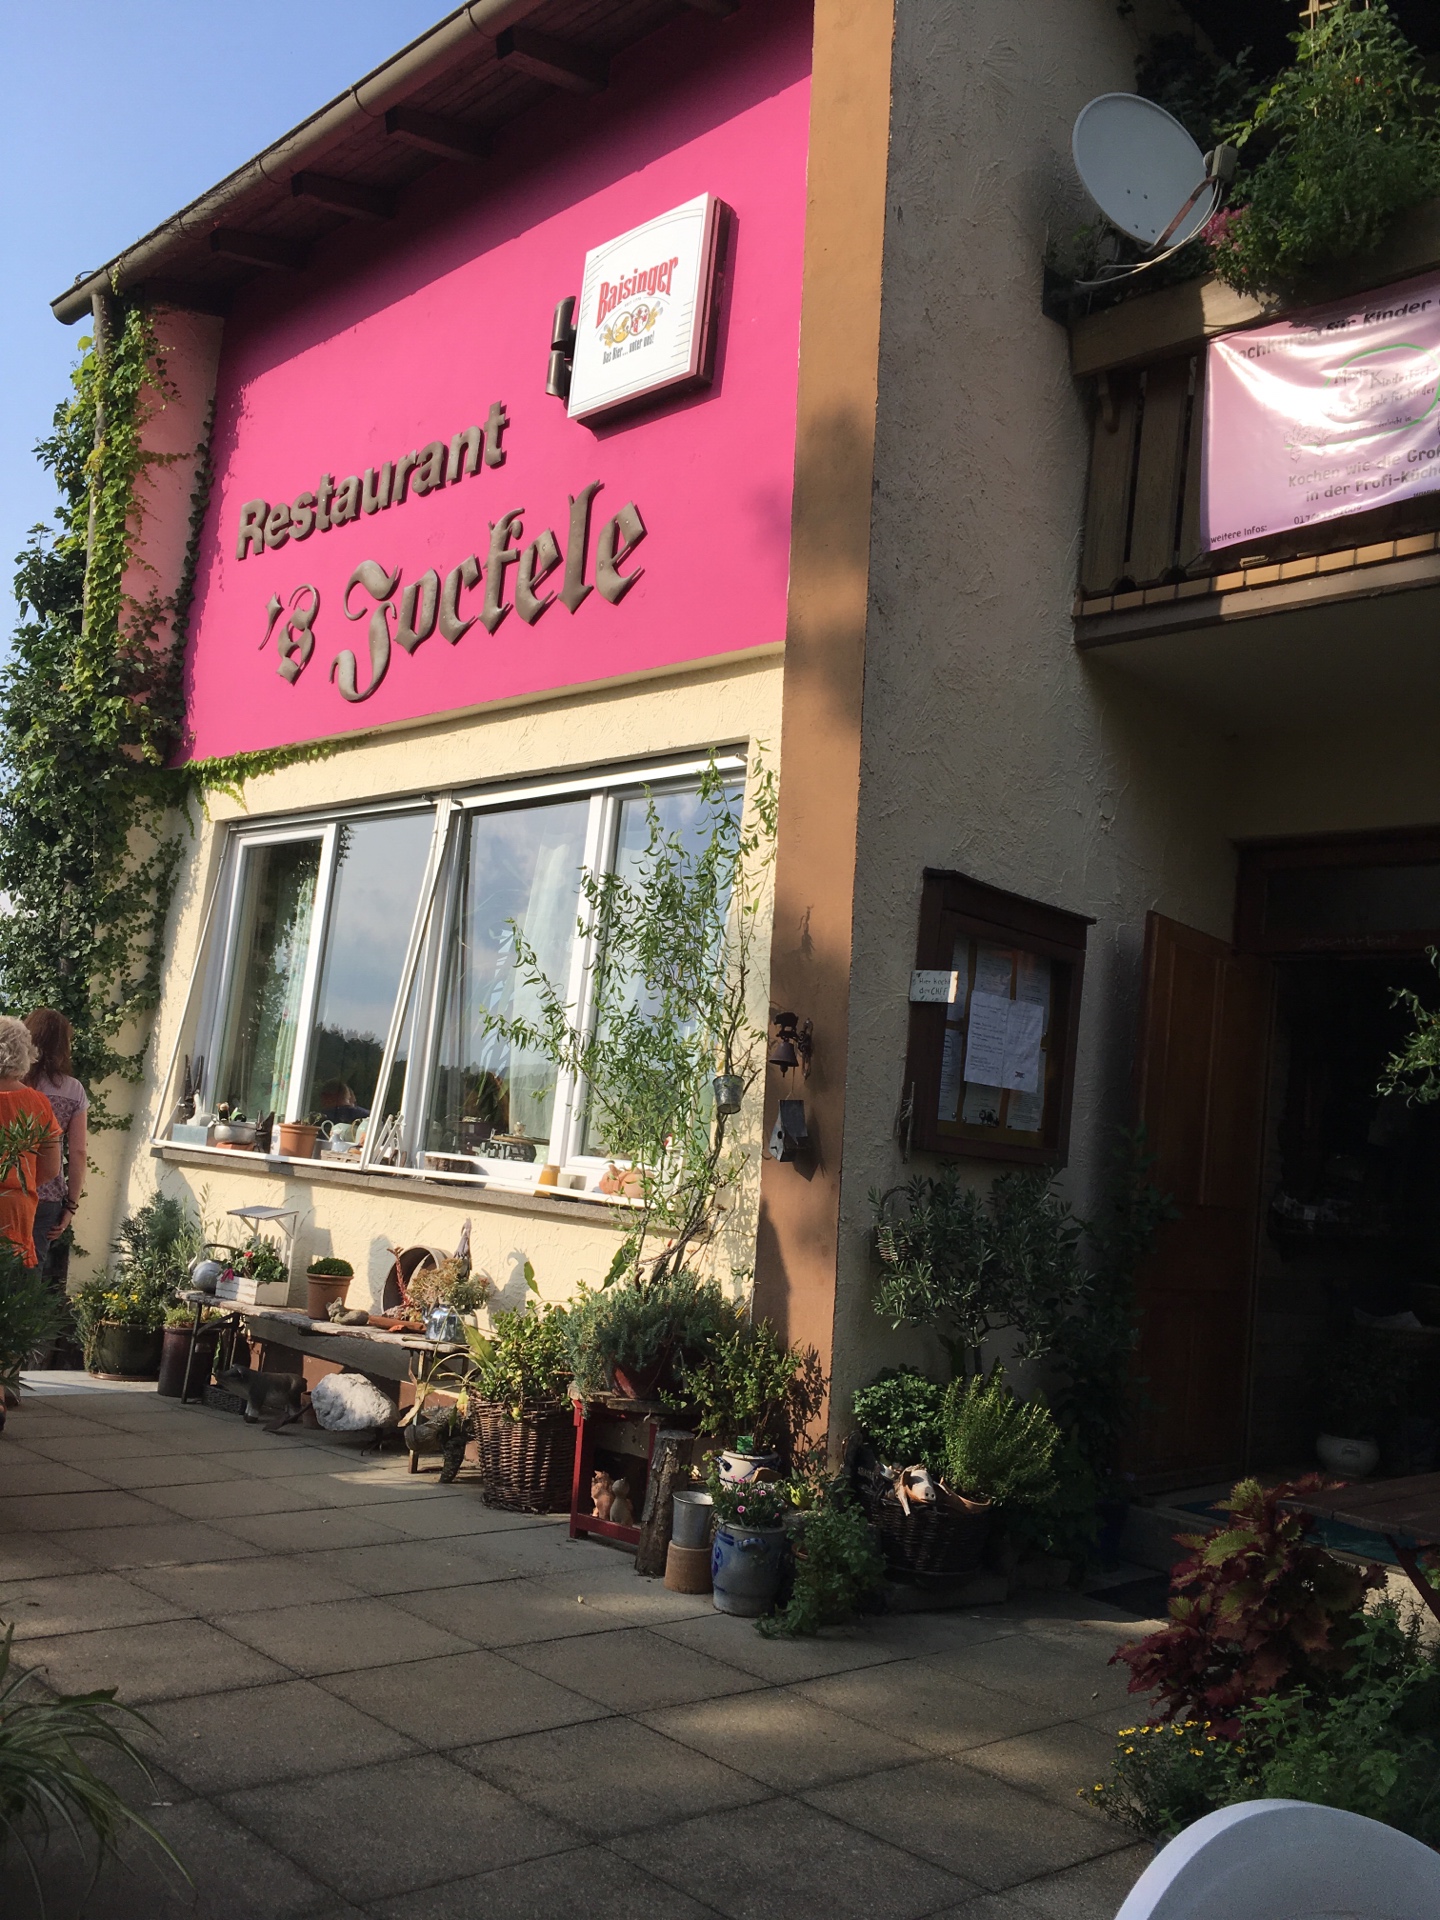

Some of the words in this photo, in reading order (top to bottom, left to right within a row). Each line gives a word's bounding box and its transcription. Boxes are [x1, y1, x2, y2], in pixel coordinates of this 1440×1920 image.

[595, 256, 679, 329] Baisinger
[1363, 299, 1432, 324] Kinder
[235, 401, 506, 560] Restaurant
[1288, 468, 1340, 488] Kochen
[1346, 461, 1371, 477] wie
[1306, 490, 1319, 503] in
[1324, 484, 1351, 498] der
[1210, 530, 1242, 544] weitere
[1244, 525, 1268, 537] Infos:
